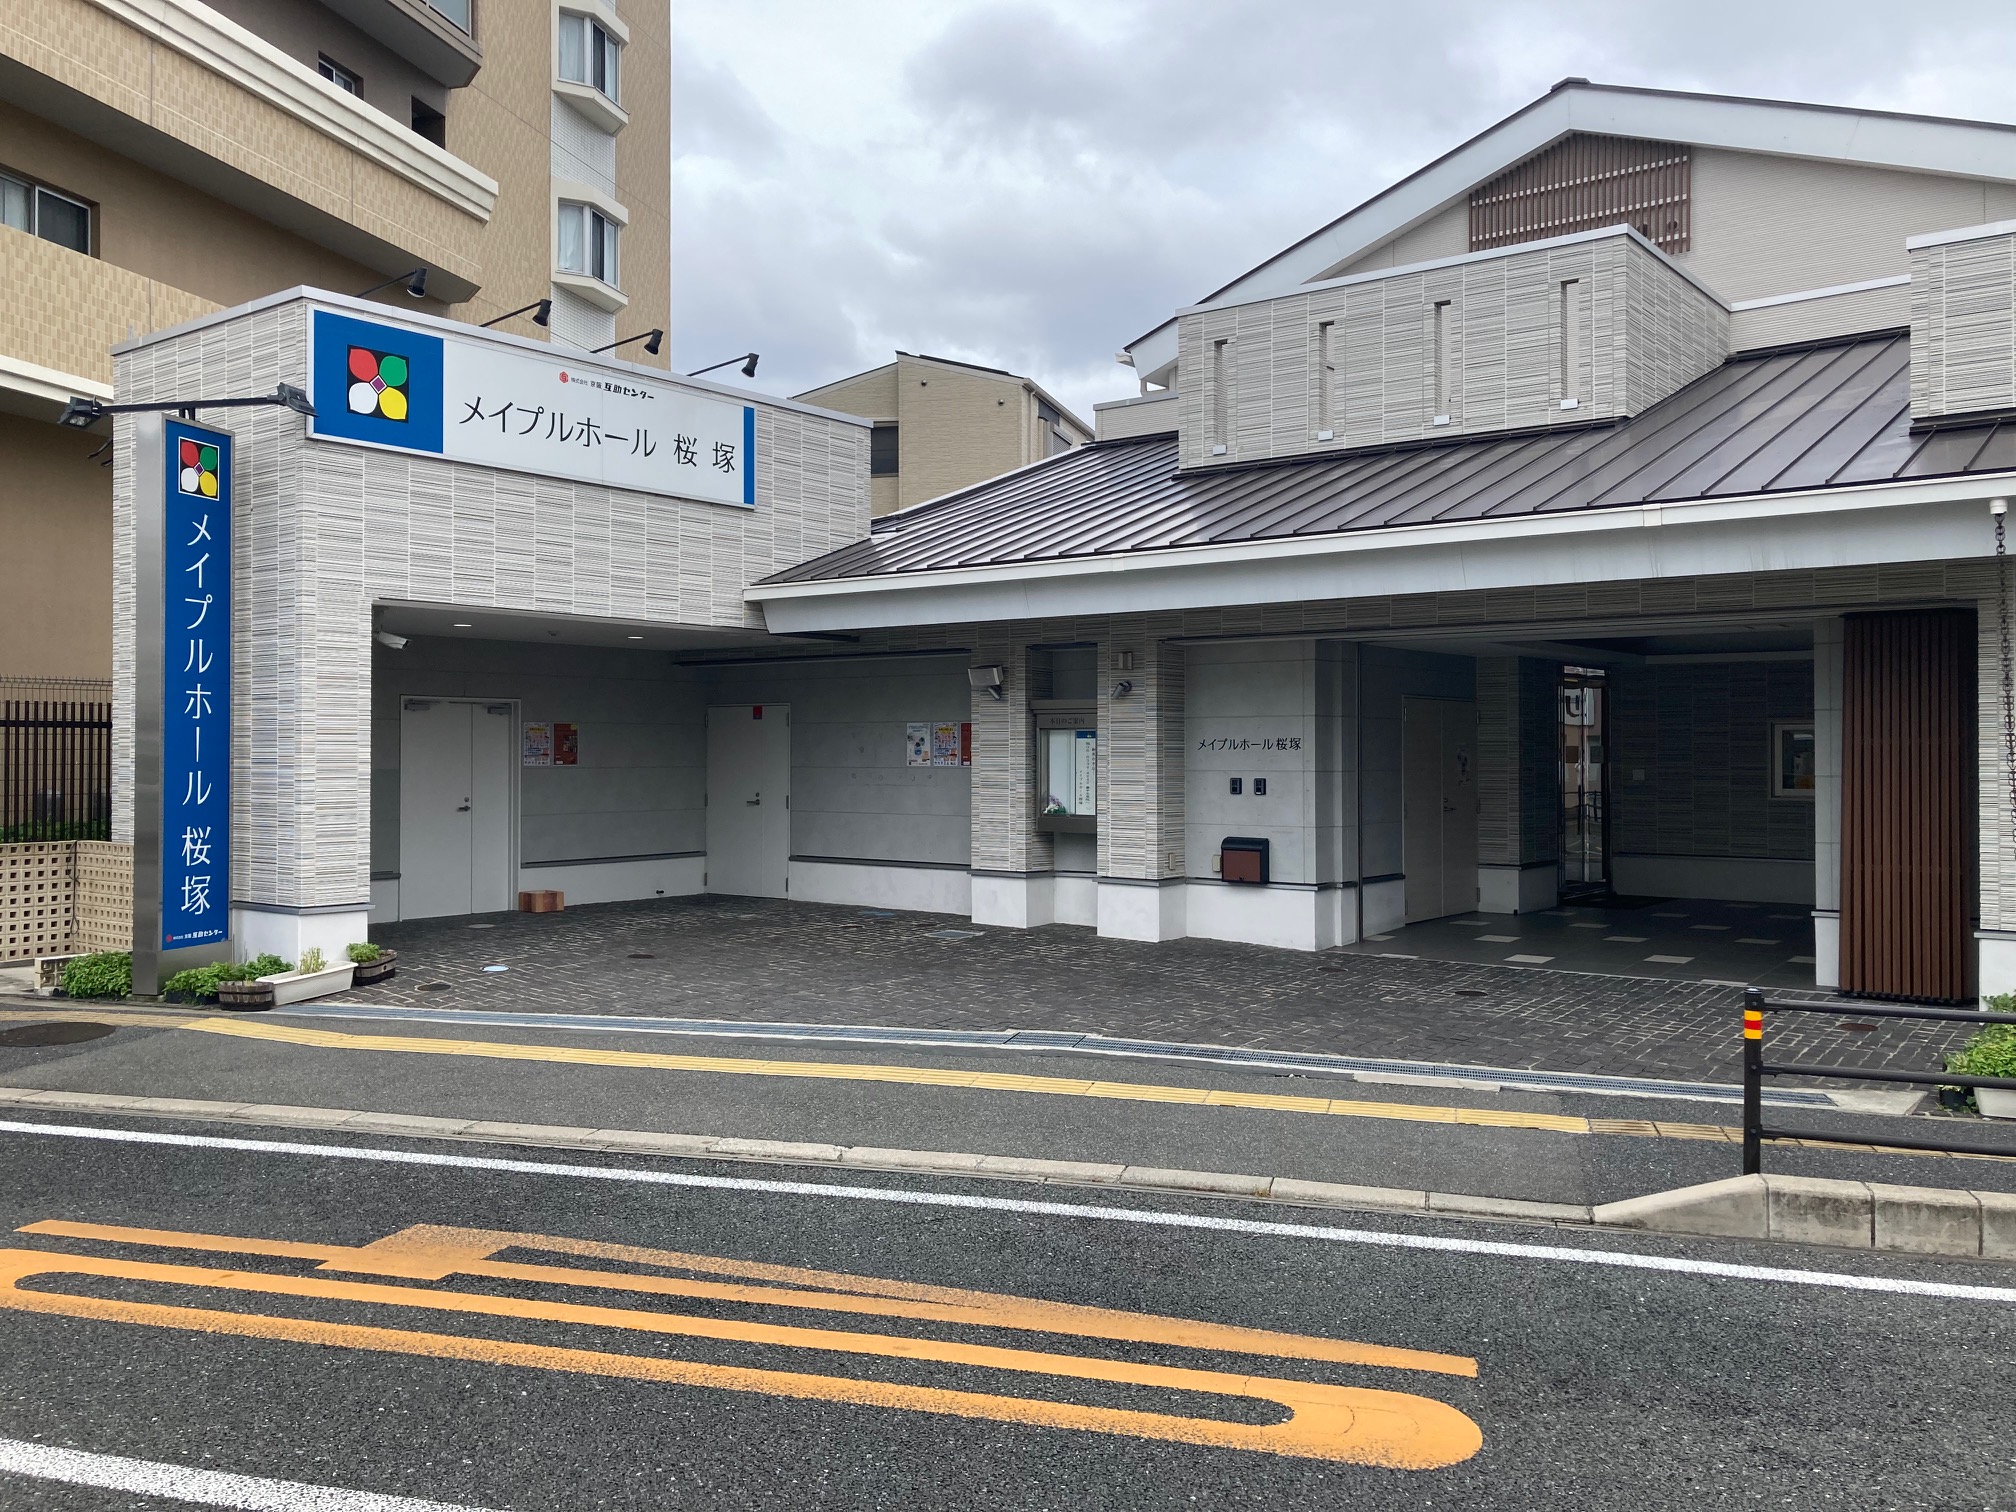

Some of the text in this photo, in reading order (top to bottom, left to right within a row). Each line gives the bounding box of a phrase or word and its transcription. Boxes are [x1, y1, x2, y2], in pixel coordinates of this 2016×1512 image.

[603, 381, 655, 400] 互助センター
[458, 395, 736, 474] メイプルホール 桜塚
[180, 513, 214, 916] メイプルホール 桜塚
